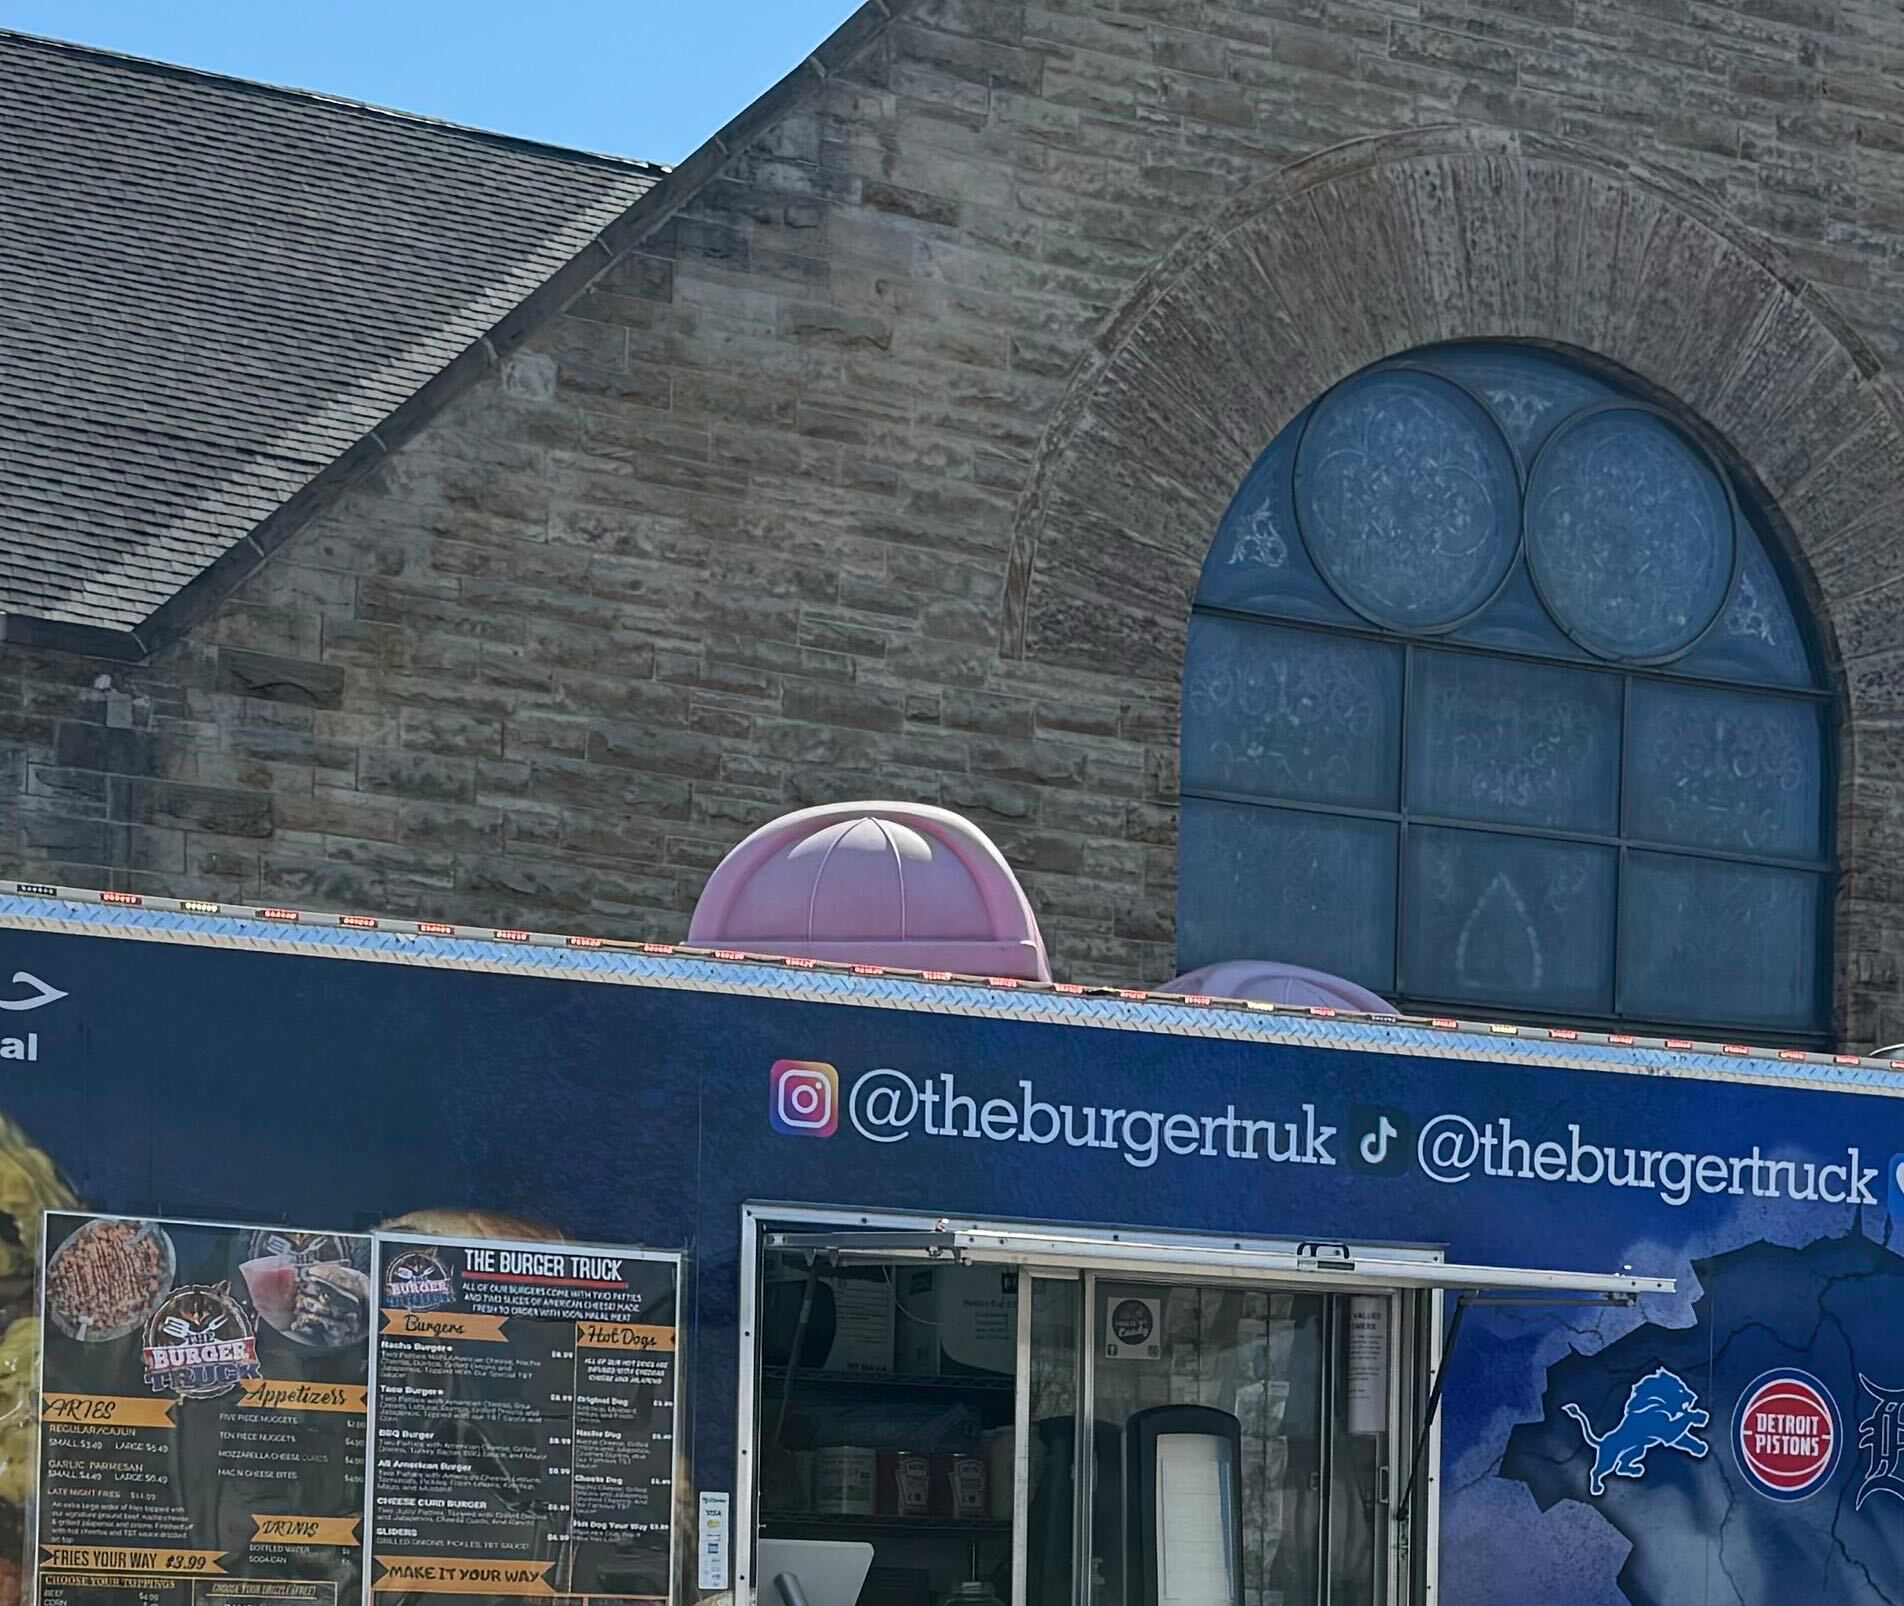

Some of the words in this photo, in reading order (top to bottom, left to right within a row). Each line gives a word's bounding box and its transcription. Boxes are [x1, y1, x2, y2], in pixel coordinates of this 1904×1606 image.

[848, 1068, 1337, 1168] @theburgertruk
[1416, 1114, 1878, 1206] @theburgertruck
[464, 1249, 495, 1272] THE
[500, 1252, 564, 1277] BURGER
[571, 1256, 622, 1281] TRUCK
[462, 1283, 475, 1291] ALL
[477, 1284, 488, 1292] OF
[490, 1285, 507, 1293] OUR
[509, 1286, 545, 1295] BURGERS
[547, 1288, 569, 1297] COME
[571, 1290, 591, 1298] WITH
[593, 1292, 610, 1300] TWO
[613, 1293, 642, 1302] PATTIES
[464, 1293, 481, 1301] AND
[503, 1296, 529, 1304] SLICES
[543, 1299, 583, 1309] AMERICAN
[473, 1304, 497, 1312] FRESH
[499, 1306, 510, 1314] TO
[511, 1307, 538, 1316] ORDER
[539, 1309, 560, 1317] WITH
[585, 1311, 609, 1320] HALAL
[610, 1313, 631, 1322] MEAT
[404, 1315, 465, 1337] Burgers
[185, 1332, 216, 1346] THE
[588, 1325, 619, 1343] Hot
[621, 1328, 657, 1349] Dogs
[381, 1341, 412, 1351] Nacho
[151, 1342, 250, 1369] BURGER
[144, 1364, 263, 1392] TRUCK
[246, 1382, 346, 1408] Appetizers
[380, 1385, 403, 1393] Taco
[220, 1413, 236, 1421] FIVE
[238, 1414, 258, 1422] PIECE
[261, 1415, 298, 1424] NUGGETS
[1755, 1413, 1819, 1435] DETROIT
[220, 1432, 235, 1440] TEN
[236, 1432, 257, 1441] PIECE
[259, 1433, 296, 1443] NUGGETS
[379, 1429, 400, 1438] BBQ
[402, 1430, 434, 1440] Burger
[1755, 1434, 1819, 1456] PISTONS
[218, 1450, 269, 1459] MOZZARELLA
[48, 1459, 85, 1470] GARLIC
[89, 1461, 144, 1472] PARMESAN
[378, 1459, 391, 1468] All
[393, 1460, 438, 1471] American
[440, 1462, 472, 1472] Burger
[47, 1487, 68, 1496] LATE
[98, 1489, 121, 1498] FRIES
[377, 1497, 416, 1506] CHEESE
[418, 1499, 445, 1507] CURD
[447, 1499, 487, 1509] BURGER
[376, 1528, 418, 1537] SLIDERS
[249, 1544, 283, 1552] BOTTLED
[53, 1550, 89, 1566] FRIES
[93, 1550, 127, 1567] YOUR
[130, 1552, 157, 1569] WAY
[165, 1555, 206, 1570] $3.99
[388, 1566, 436, 1580] MAKE
[440, 1568, 456, 1580] IT
[460, 1569, 501, 1582] YOUR
[505, 1569, 539, 1583] WAY
[45, 1576, 88, 1586] CHOOSE
[90, 1577, 120, 1587] YOUR
[122, 1578, 175, 1589] TOPPINGS
[43, 1599, 67, 1606] CORN
